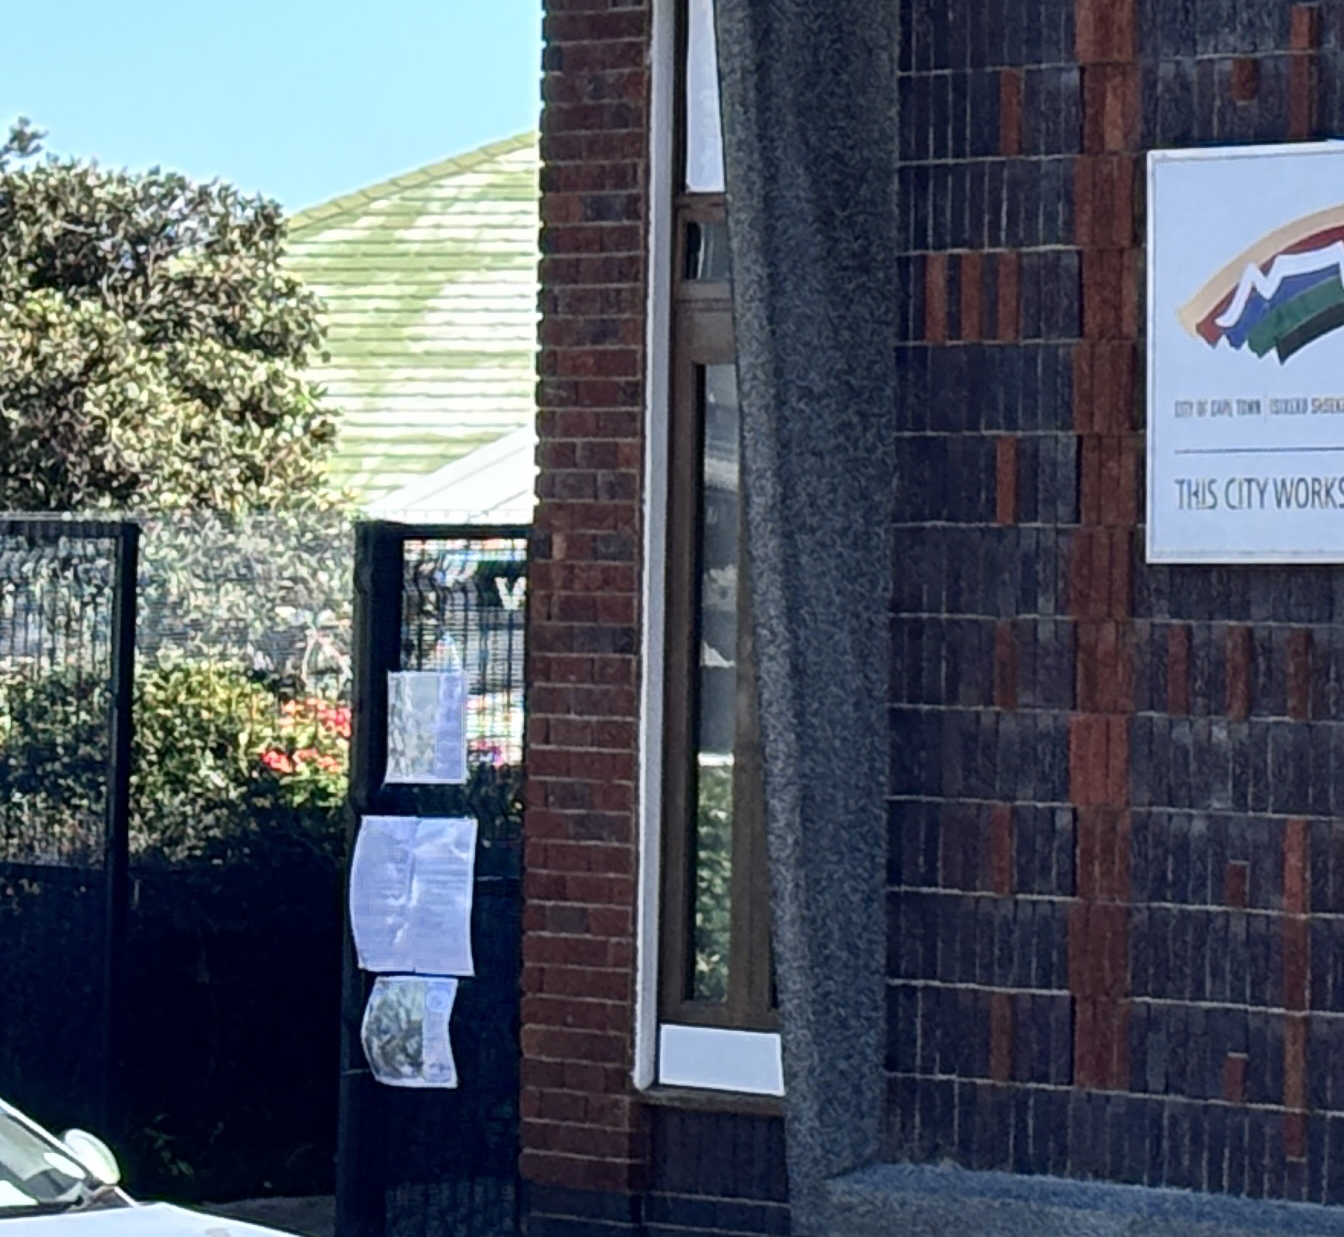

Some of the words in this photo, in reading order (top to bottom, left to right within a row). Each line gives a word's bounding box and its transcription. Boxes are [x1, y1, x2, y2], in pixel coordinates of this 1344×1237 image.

[1236, 397, 1262, 416] TOWN
[1174, 477, 1218, 510] THIS
[1224, 476, 1270, 510] CITY
